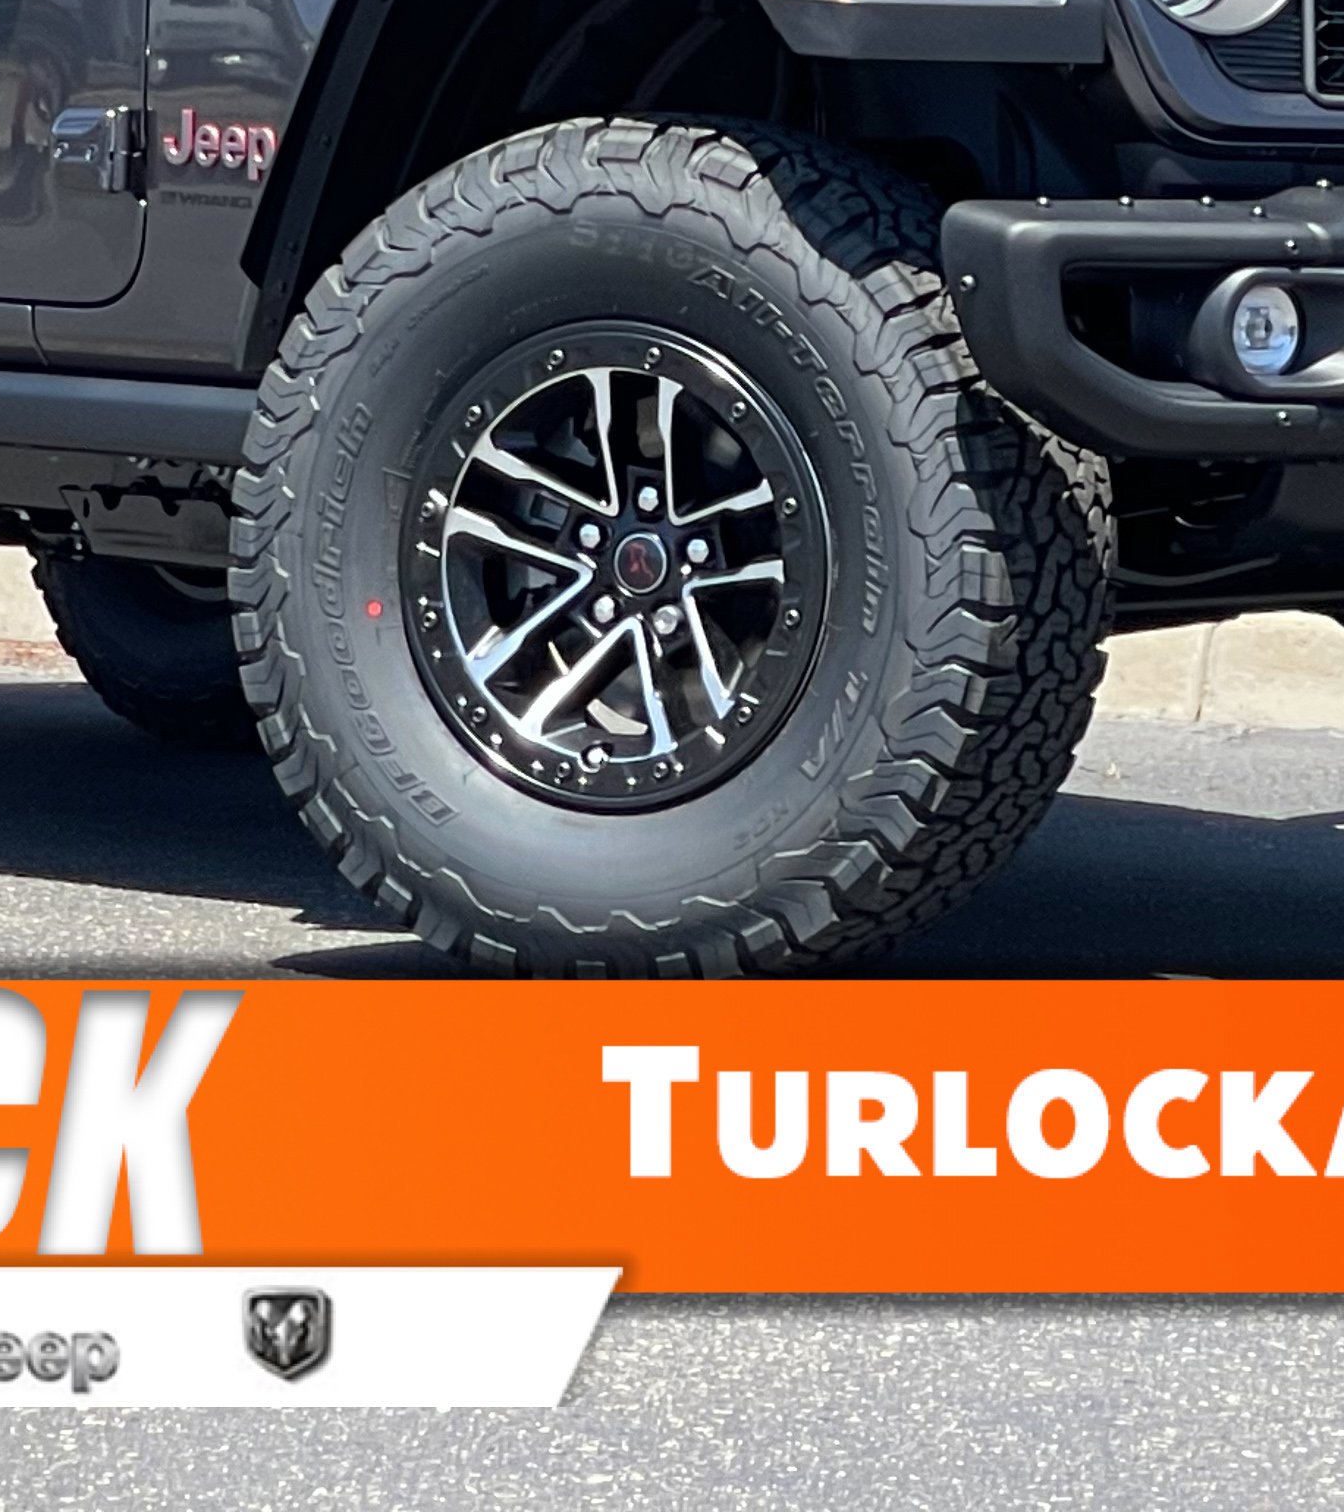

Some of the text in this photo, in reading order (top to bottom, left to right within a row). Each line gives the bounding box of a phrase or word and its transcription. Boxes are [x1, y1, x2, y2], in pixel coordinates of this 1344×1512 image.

[162, 106, 279, 181] Jeep
[311, 400, 462, 828] BFGoodrich
[684, 263, 892, 636] All-Terrain
